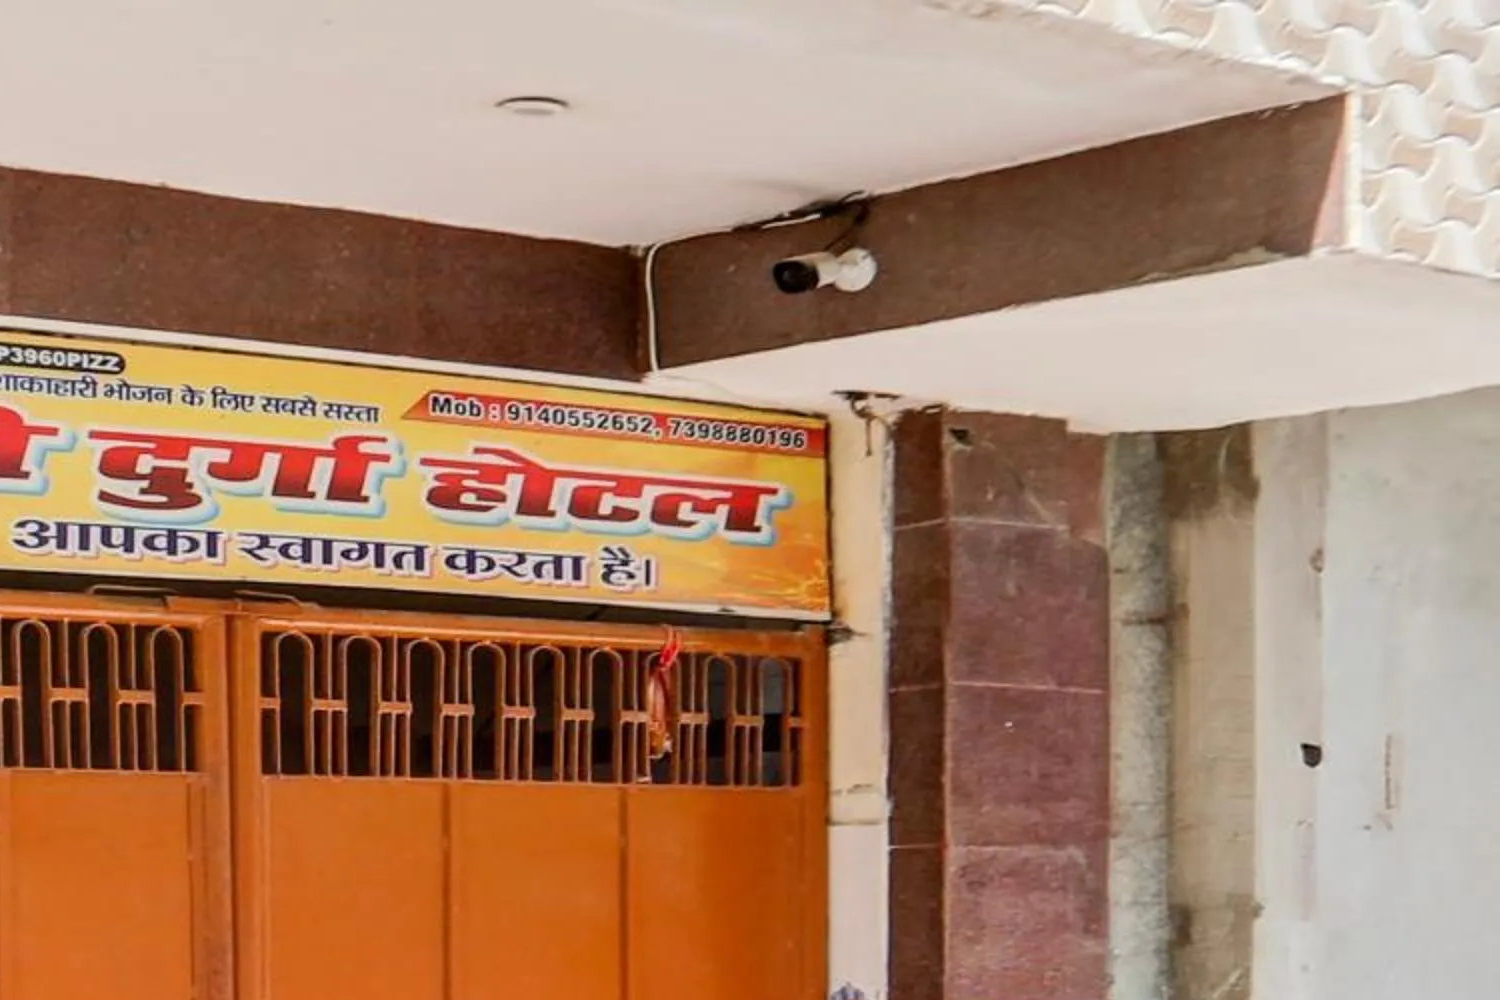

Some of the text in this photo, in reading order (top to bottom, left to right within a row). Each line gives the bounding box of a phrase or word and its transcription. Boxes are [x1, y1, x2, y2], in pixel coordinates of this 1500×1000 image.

[103, 379, 172, 405] भोजन
[180, 384, 205, 407] के
[211, 387, 256, 412] लिए
[261, 395, 317, 417] सबसे
[323, 402, 380, 423] सस्ता
[431, 397, 482, 418] Mob
[508, 405, 661, 437] 9140552652,
[668, 419, 805, 449] 7398880196
[88, 431, 392, 511] दुर्गा
[419, 447, 780, 533] होटल
[12, 518, 222, 558] आपका
[237, 531, 428, 573] स्वागत
[444, 547, 587, 582] करता
